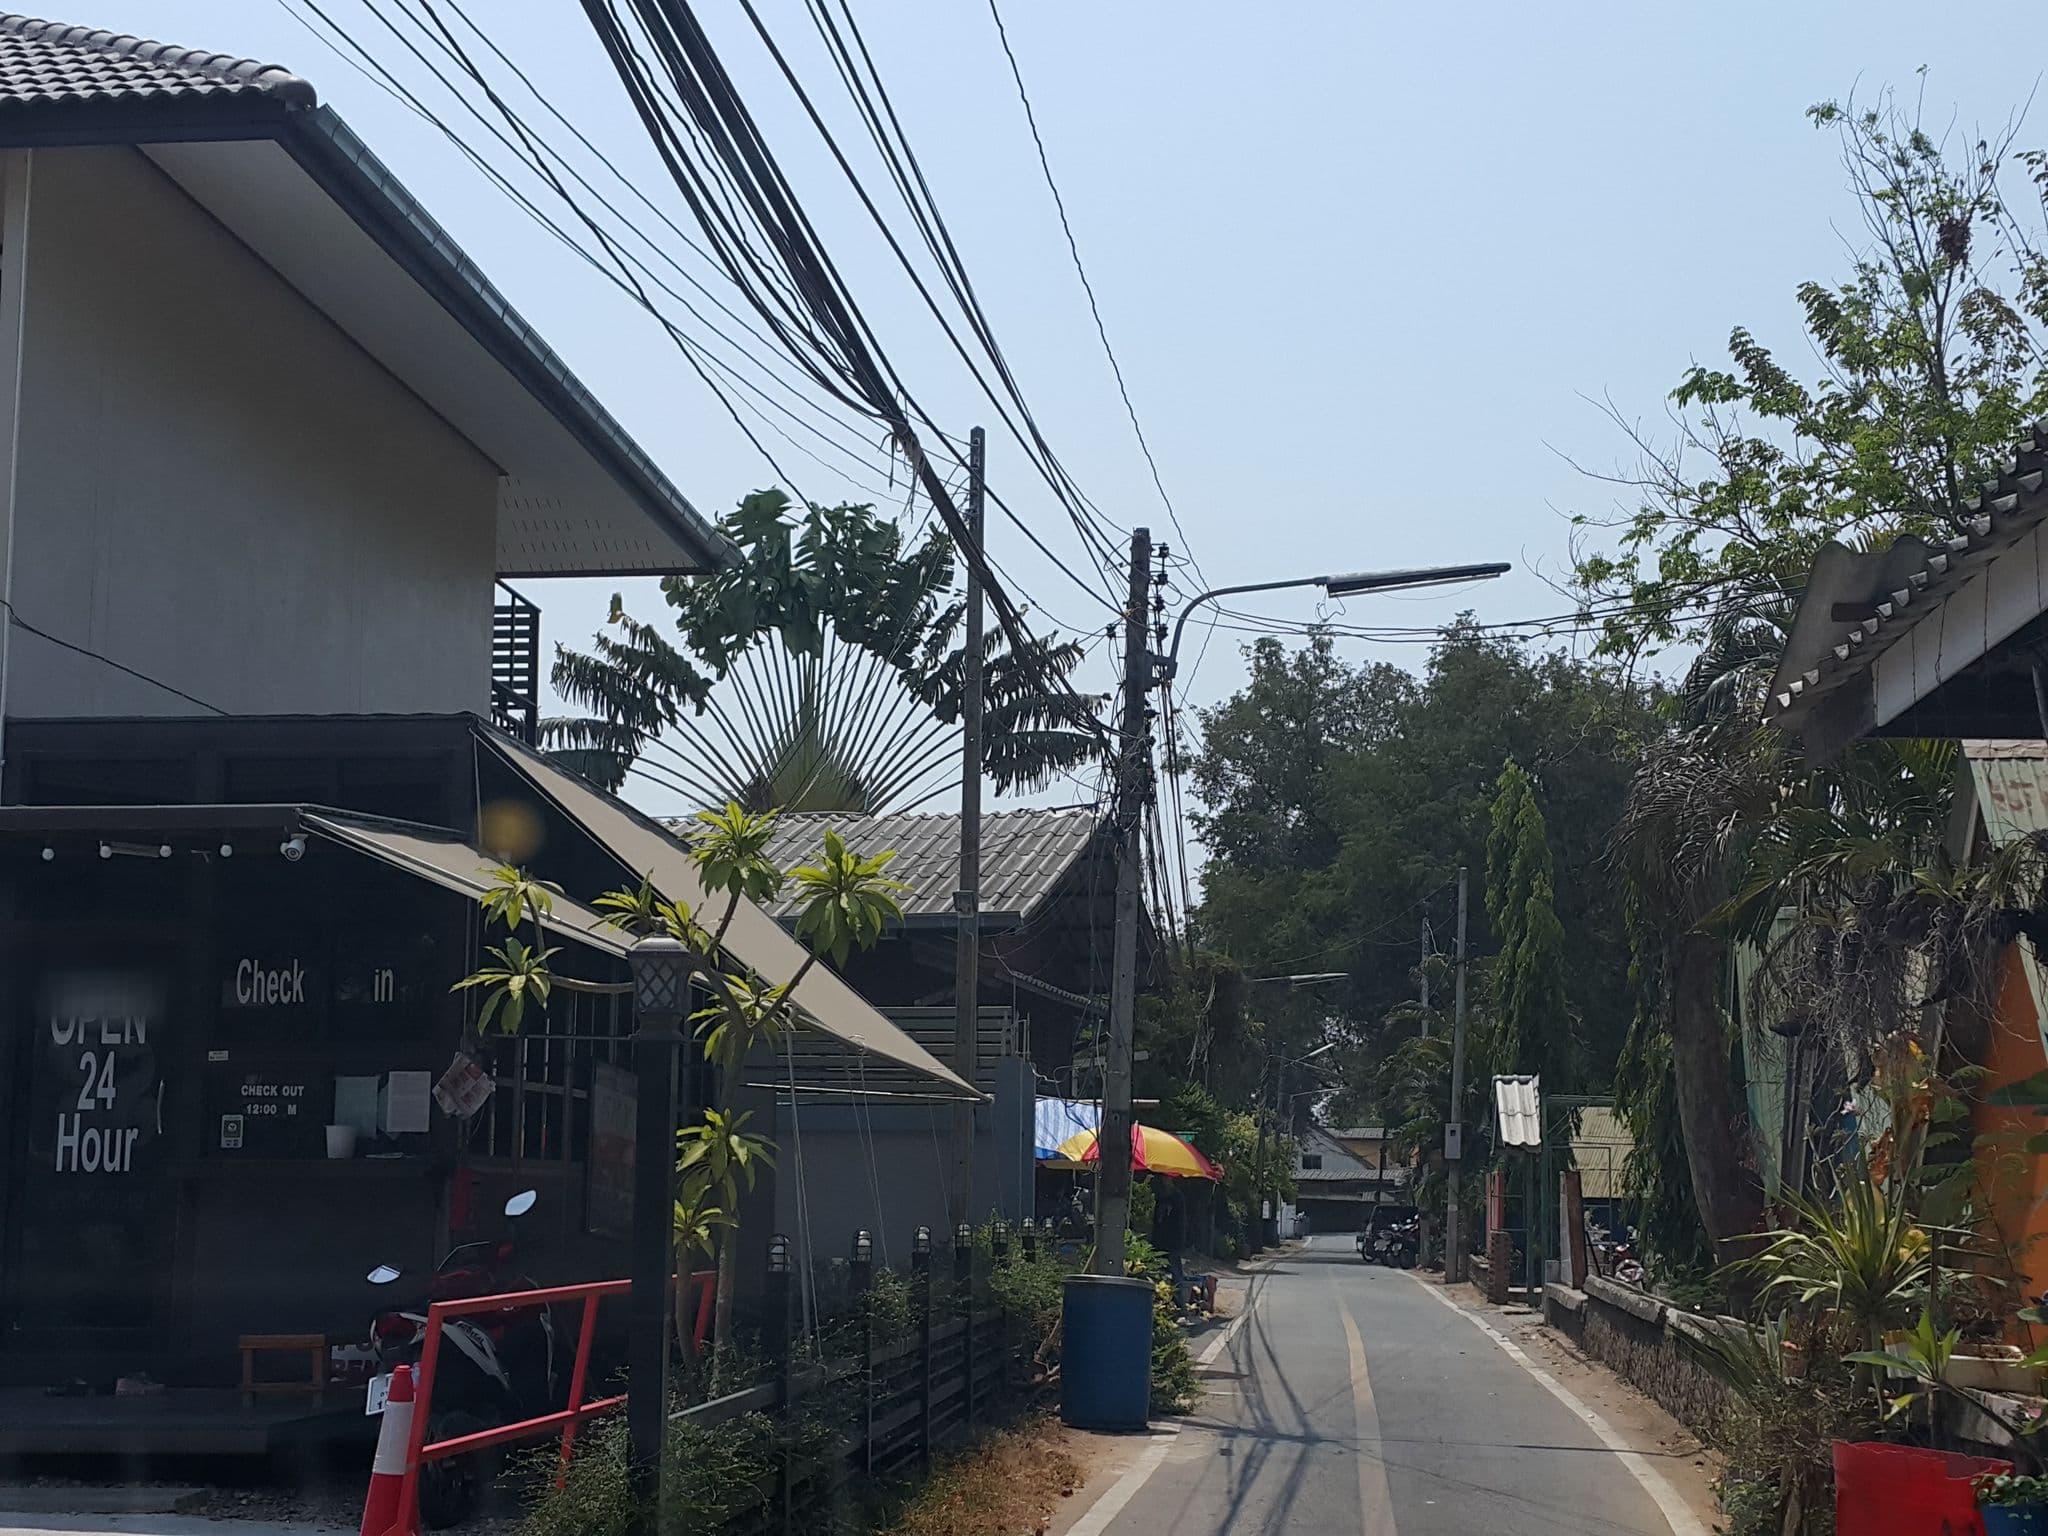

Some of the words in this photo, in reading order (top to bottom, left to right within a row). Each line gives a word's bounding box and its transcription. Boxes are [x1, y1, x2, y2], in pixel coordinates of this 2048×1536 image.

[236, 958, 304, 1004] Check
[374, 968, 394, 1002] in
[76, 1051, 117, 1110] 24
[240, 1084, 279, 1097] CHECK
[282, 1084, 305, 1097] OUT
[245, 1103, 278, 1115] 12:00
[55, 1112, 139, 1173] Hour
